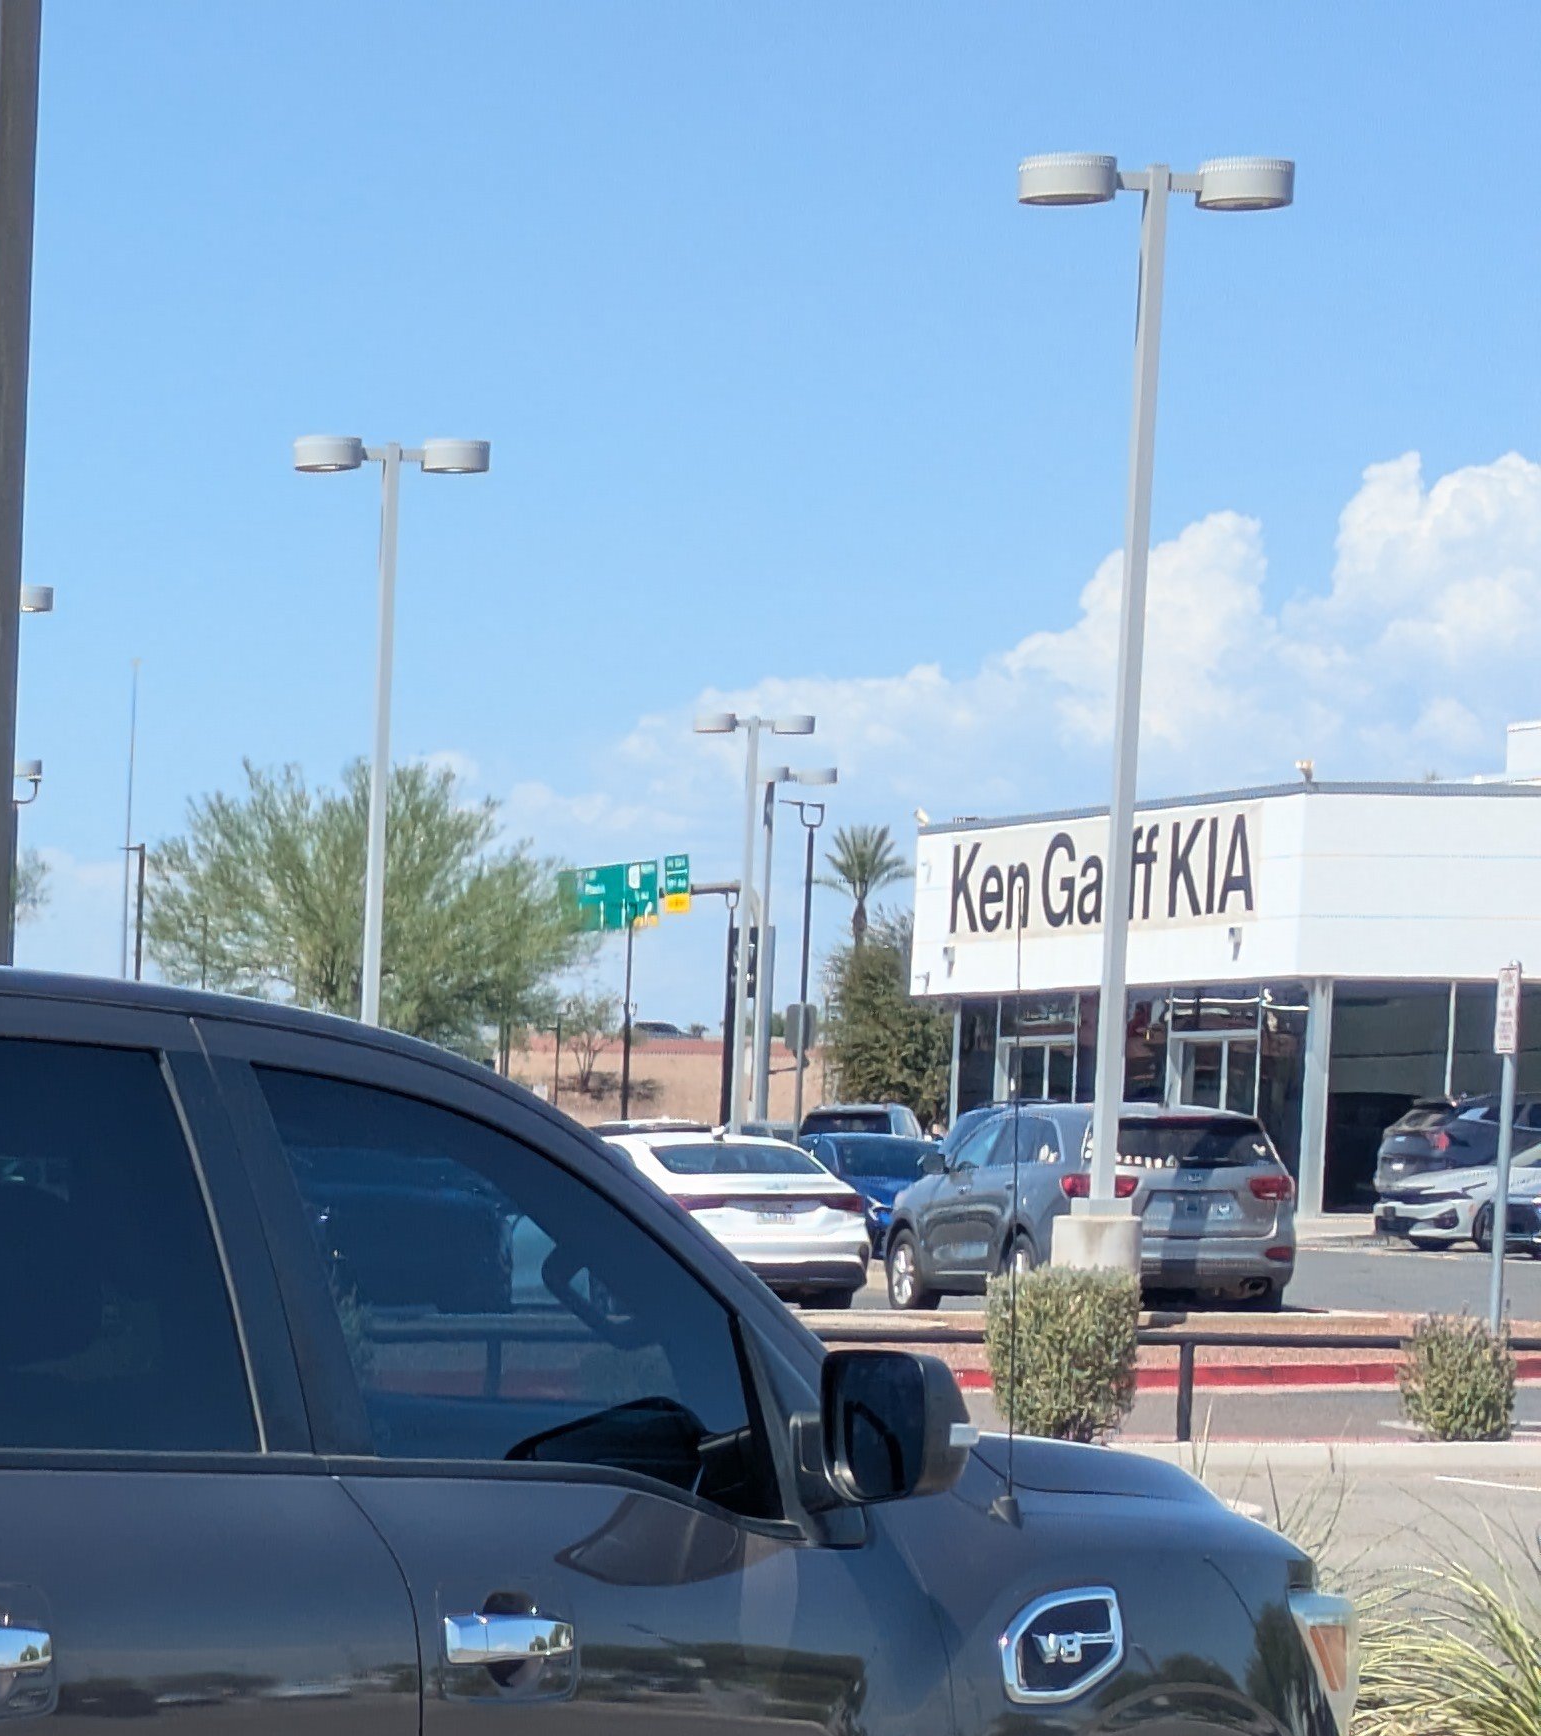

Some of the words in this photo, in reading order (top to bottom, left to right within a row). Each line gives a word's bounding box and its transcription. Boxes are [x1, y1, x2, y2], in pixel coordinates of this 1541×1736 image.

[949, 842, 1030, 933] Ken
[1041, 822, 1159, 928] Gaff
[1167, 813, 1254, 918] KIA
[1032, 1631, 1082, 1664] V8
